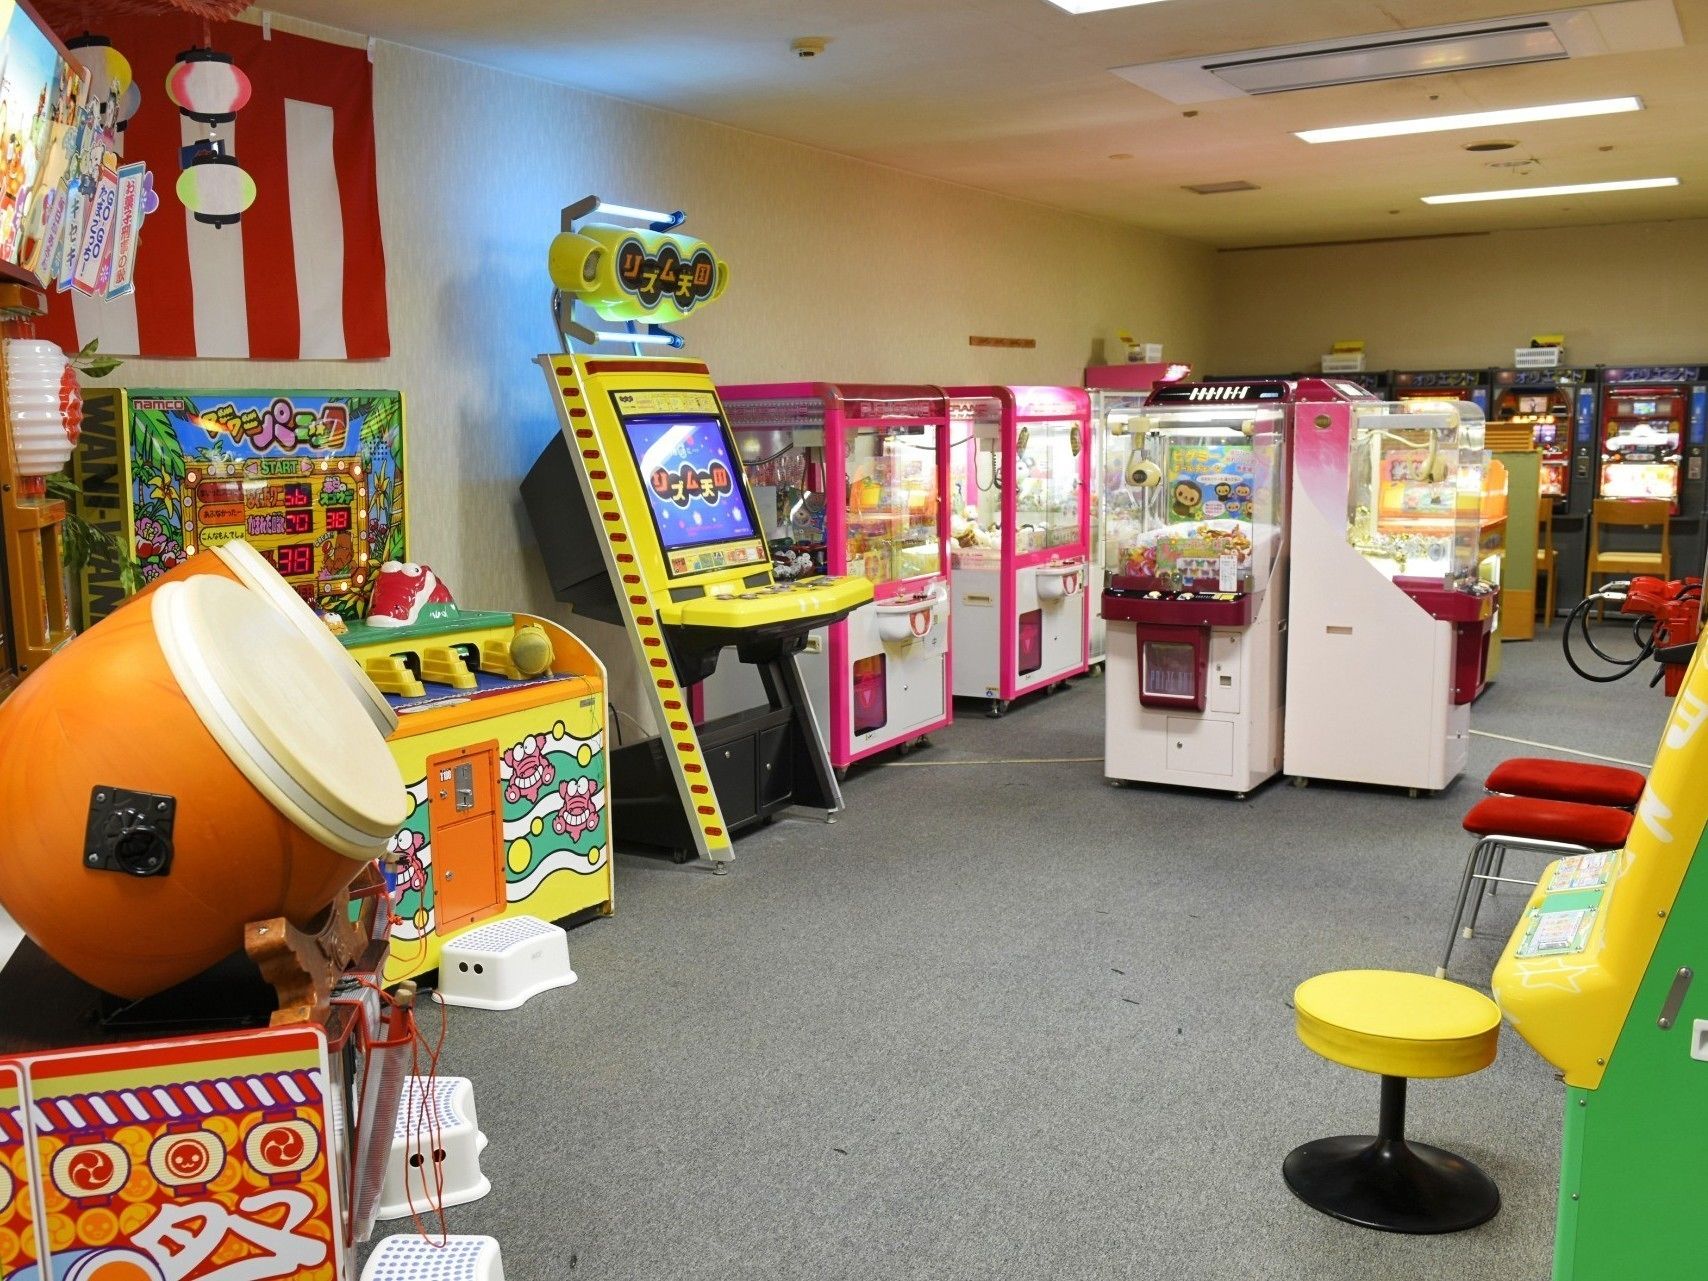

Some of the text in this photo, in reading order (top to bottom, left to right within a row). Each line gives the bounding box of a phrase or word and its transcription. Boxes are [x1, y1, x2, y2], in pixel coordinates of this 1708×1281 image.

[623, 253, 711, 297] リズム天国
[134, 400, 184, 410] namco
[261, 460, 298, 474] START
